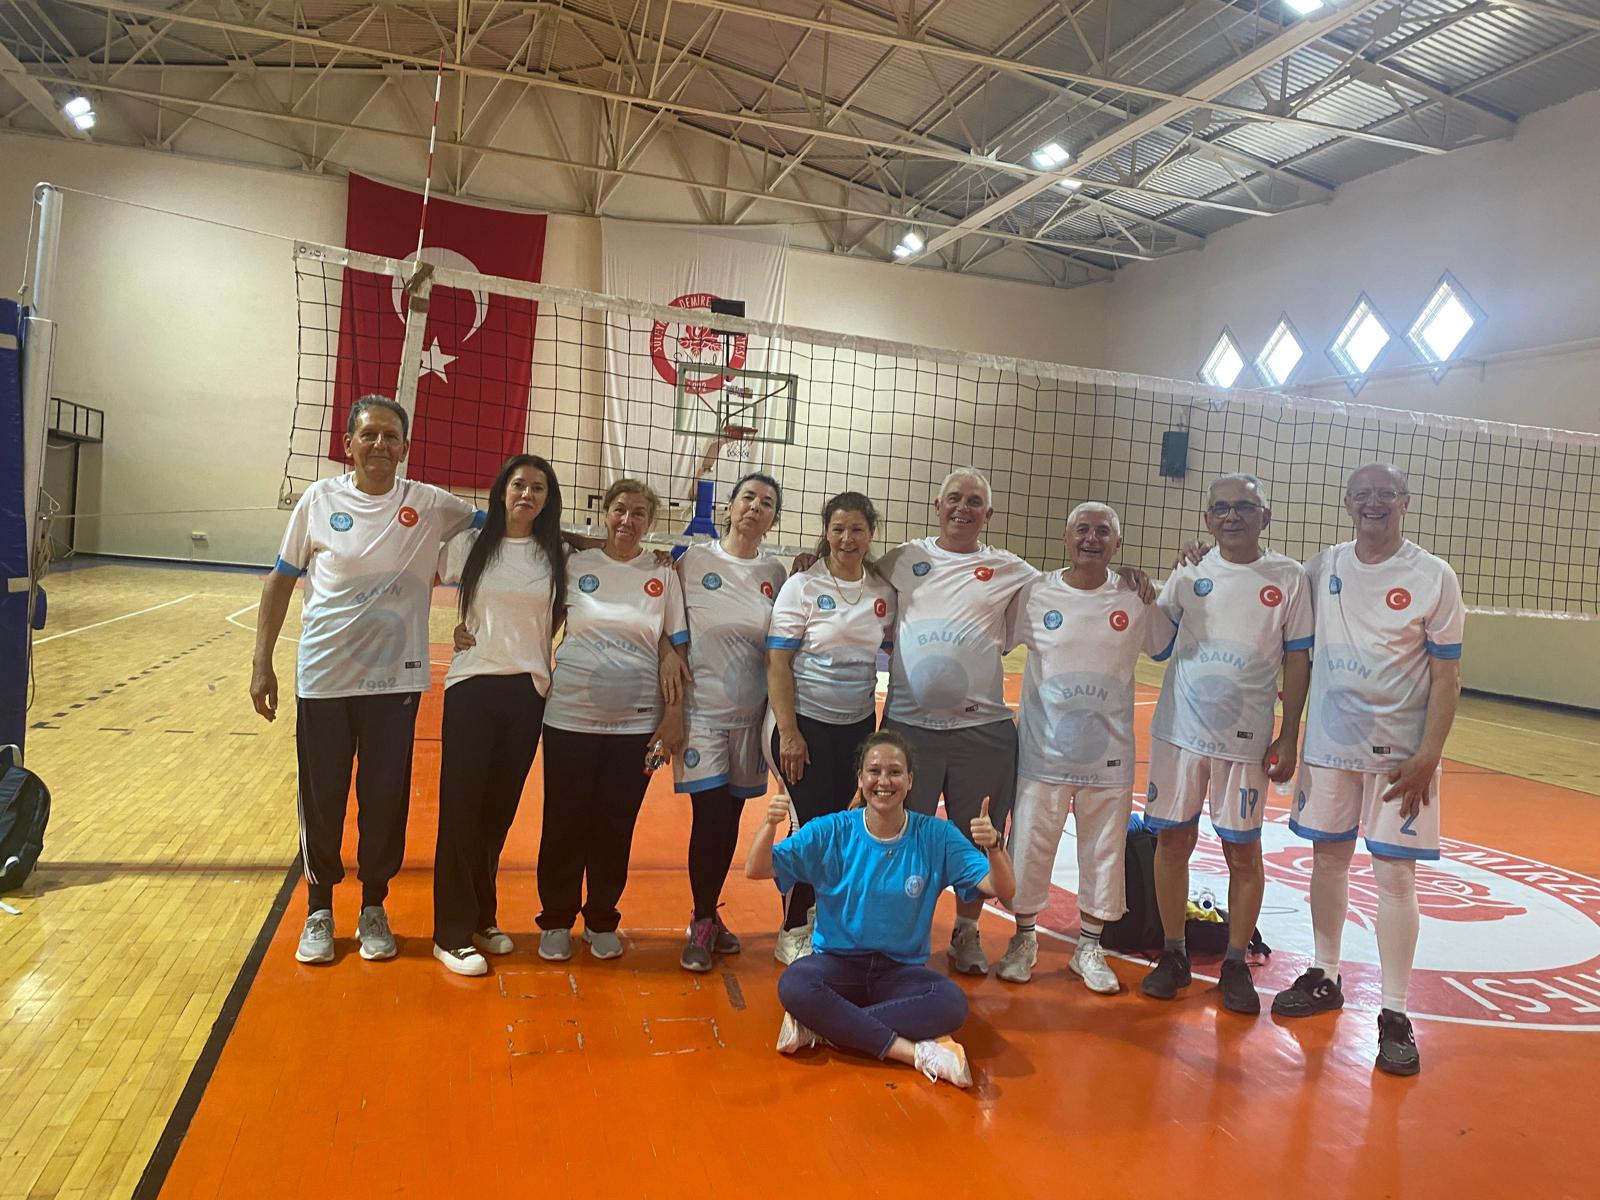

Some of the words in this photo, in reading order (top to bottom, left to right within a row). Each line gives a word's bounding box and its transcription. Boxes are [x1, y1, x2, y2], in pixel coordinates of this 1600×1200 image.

[917, 631, 965, 647] BAUN
[1199, 651, 1246, 671] BAUN
[1328, 657, 1372, 679] BAUN
[357, 676, 399, 691] 1992
[1062, 685, 1109, 702] BAUN
[1188, 735, 1229, 753] 1992
[1239, 788, 1259, 819] 19
